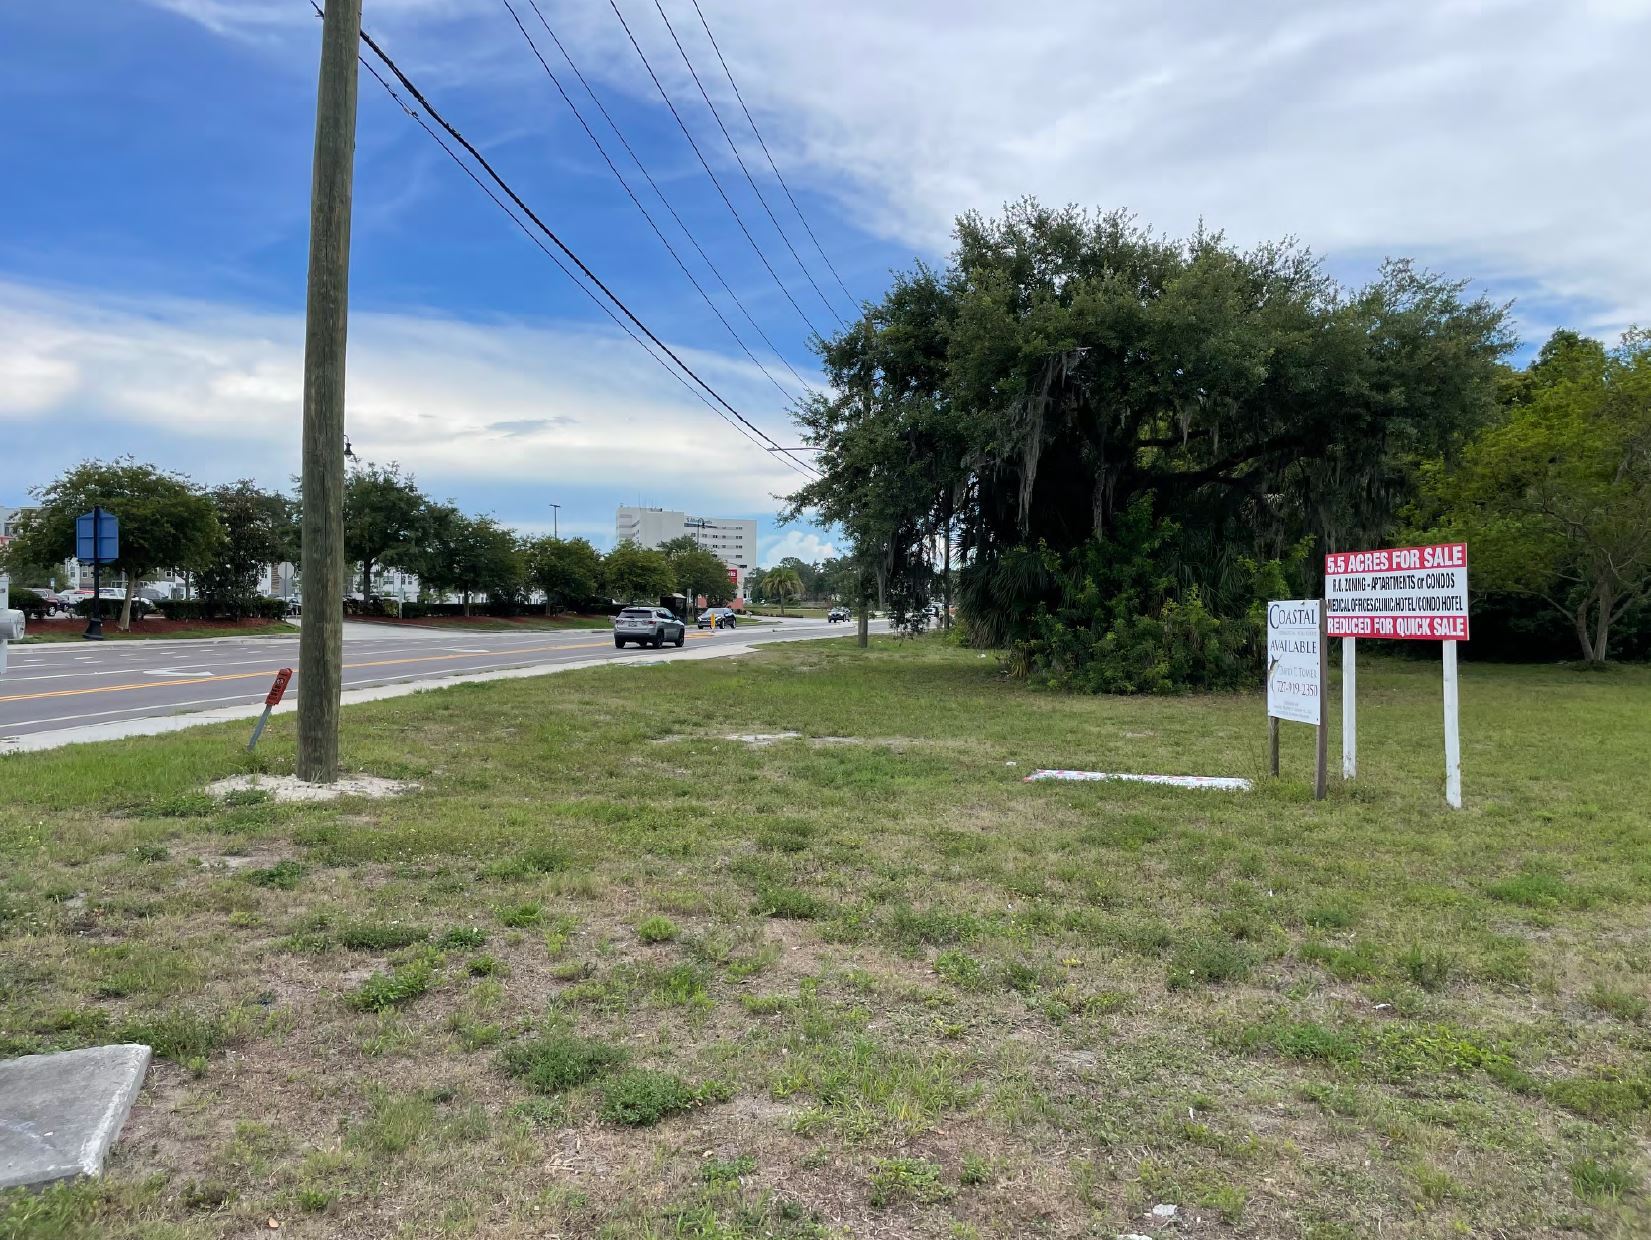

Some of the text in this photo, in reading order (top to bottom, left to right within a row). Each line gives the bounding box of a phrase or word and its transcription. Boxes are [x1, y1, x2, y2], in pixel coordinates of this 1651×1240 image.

[1327, 545, 1463, 573] 5.5 ACRES FOR SALE
[1344, 576, 1366, 592] ZONING
[1417, 578, 1424, 588] or
[1426, 572, 1455, 589] CONDOS
[1327, 598, 1351, 613] MEDICAL
[1441, 595, 1463, 612] HOTEL
[1327, 617, 1465, 637] REDUCED FOR QUICK SALE
[1270, 639, 1317, 654] AVAILABLE
